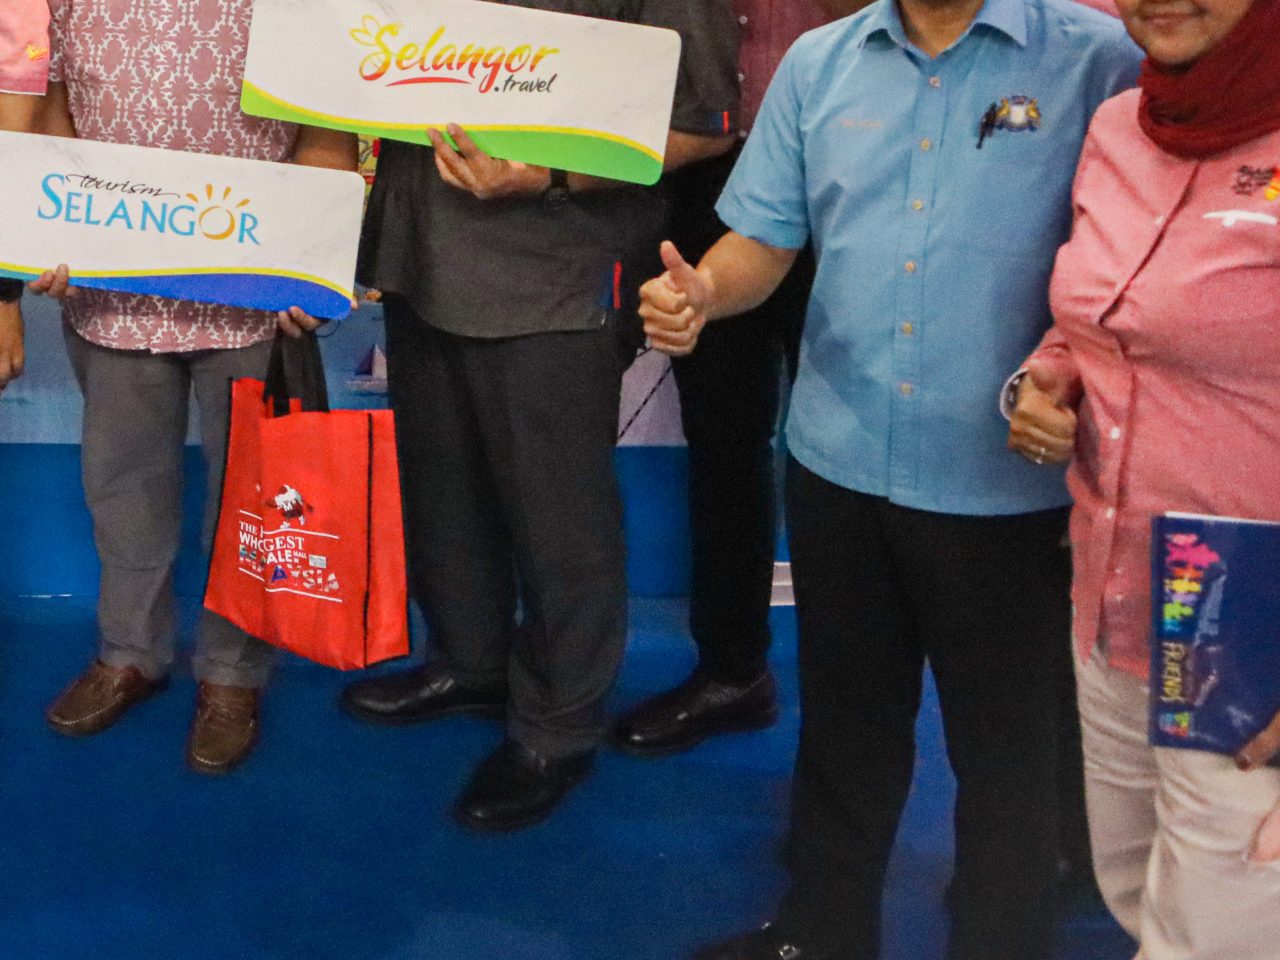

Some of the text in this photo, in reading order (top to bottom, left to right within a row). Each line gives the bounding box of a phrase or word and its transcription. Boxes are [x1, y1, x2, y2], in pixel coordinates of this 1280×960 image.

[352, 18, 581, 95] Selangor
[37, 172, 261, 246] SELANGOR
[66, 173, 181, 198] tourism
[263, 536, 305, 552] GEST
